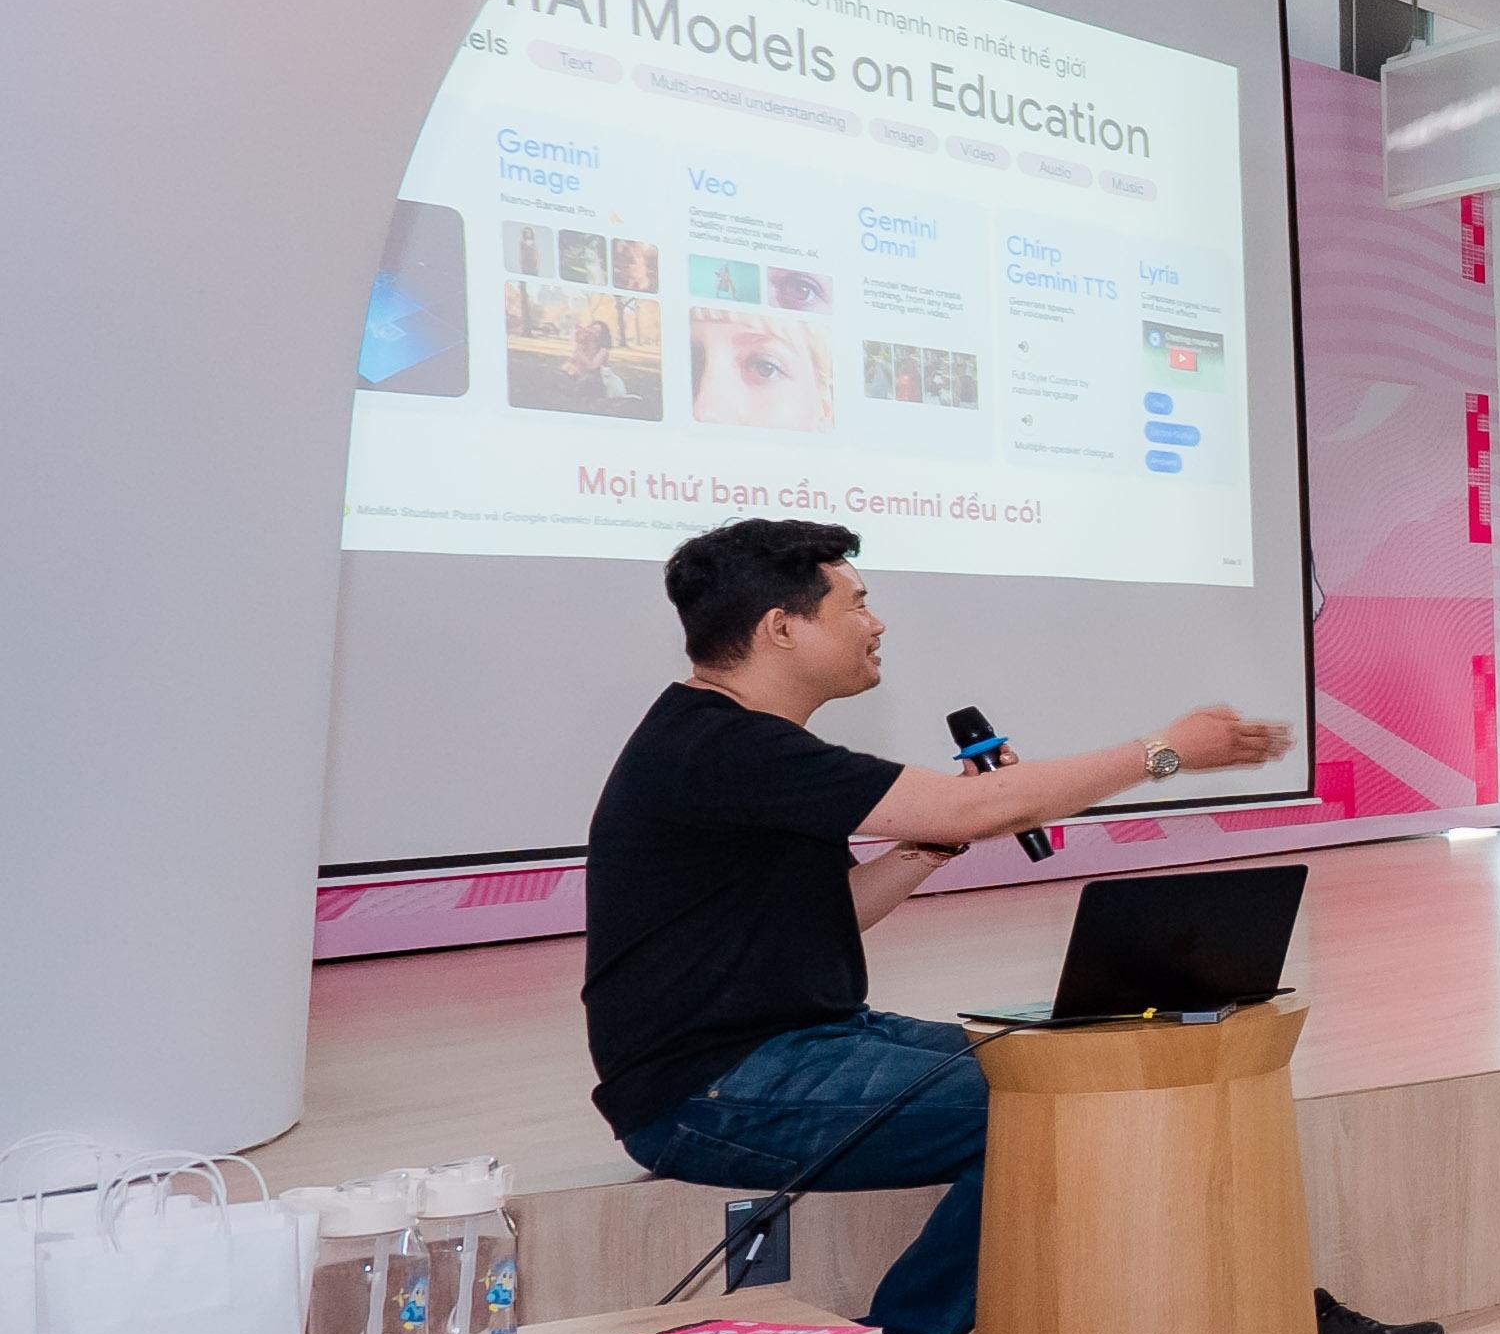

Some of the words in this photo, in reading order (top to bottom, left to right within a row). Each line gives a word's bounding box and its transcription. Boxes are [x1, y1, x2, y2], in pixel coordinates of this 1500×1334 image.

[877, 5, 932, 35] mạnh
[462, 28, 509, 56] els
[559, 50, 596, 75] Text
[746, 97, 847, 134] understanding
[884, 123, 925, 150] Image
[959, 140, 997, 164] Video
[1040, 160, 1071, 181] Audio
[1111, 174, 1144, 196] Music
[852, 55, 913, 103] on
[930, 61, 1151, 158] Education
[497, 128, 601, 170] Gemini
[500, 156, 581, 195] Image
[688, 167, 738, 197] Veo
[858, 205, 938, 241] Gemini
[861, 232, 917, 260] Omni
[1007, 235, 1062, 267] Chirp
[1007, 263, 1078, 294] Gemini
[1082, 275, 1118, 300] TTS
[1139, 260, 1180, 286] Lyria
[578, 464, 637, 506] Mọi
[646, 472, 704, 504] thứ
[711, 475, 769, 513] bạn
[845, 486, 943, 519] Gemini
[948, 492, 997, 522] đều
[1004, 499, 1043, 524] có!
[400, 506, 450, 520] Student
[452, 509, 481, 522] Pass
[503, 511, 548, 526] Google
[550, 513, 591, 526] Gemini
